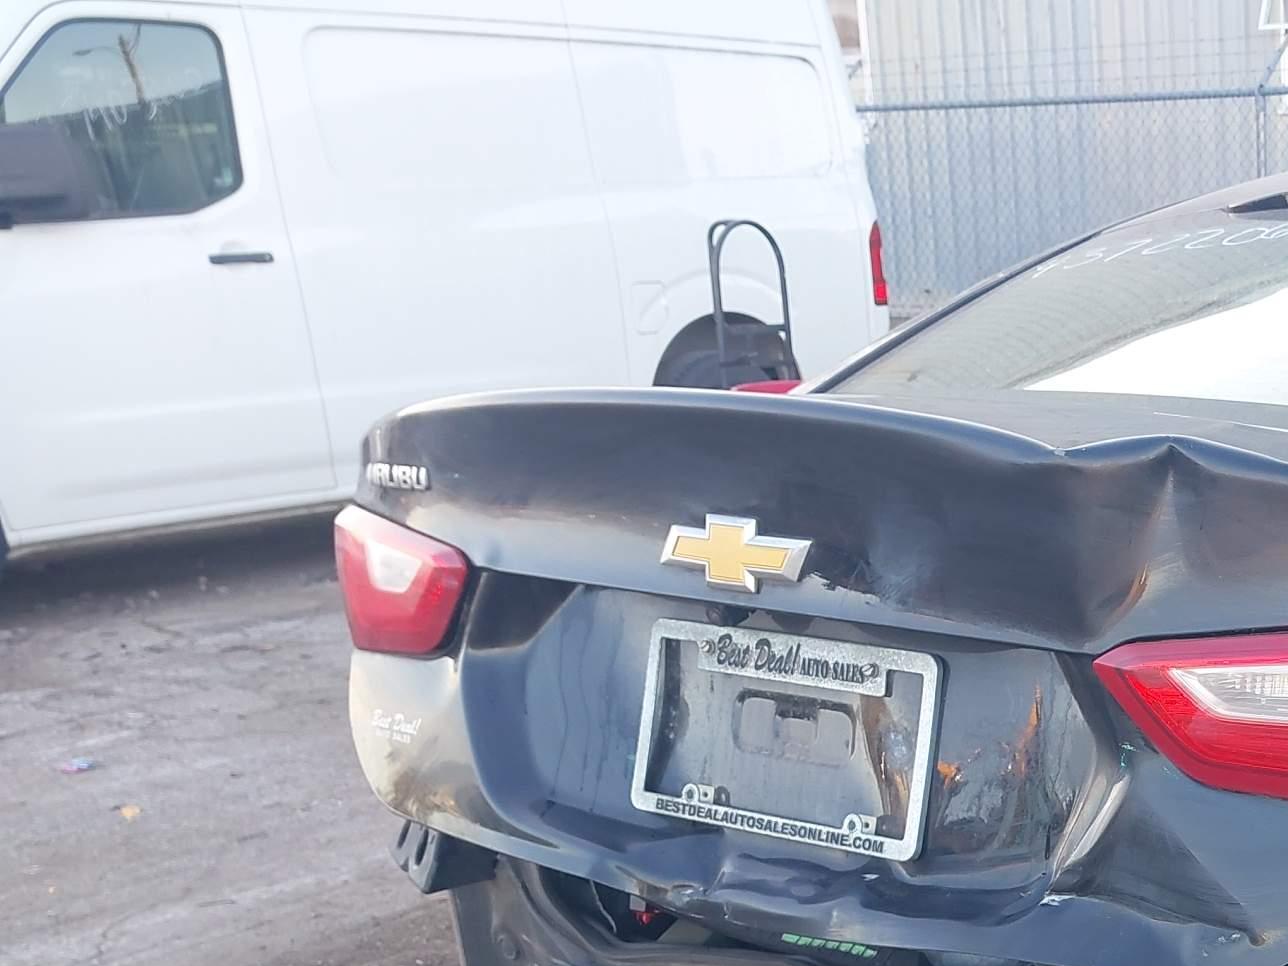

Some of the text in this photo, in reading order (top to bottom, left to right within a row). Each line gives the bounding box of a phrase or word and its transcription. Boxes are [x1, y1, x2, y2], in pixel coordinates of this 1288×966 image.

[716, 633, 865, 685] Best Deal! AUTO SALES
[655, 797, 885, 853] BESTDEALAUTOSALESONLINE.COM
